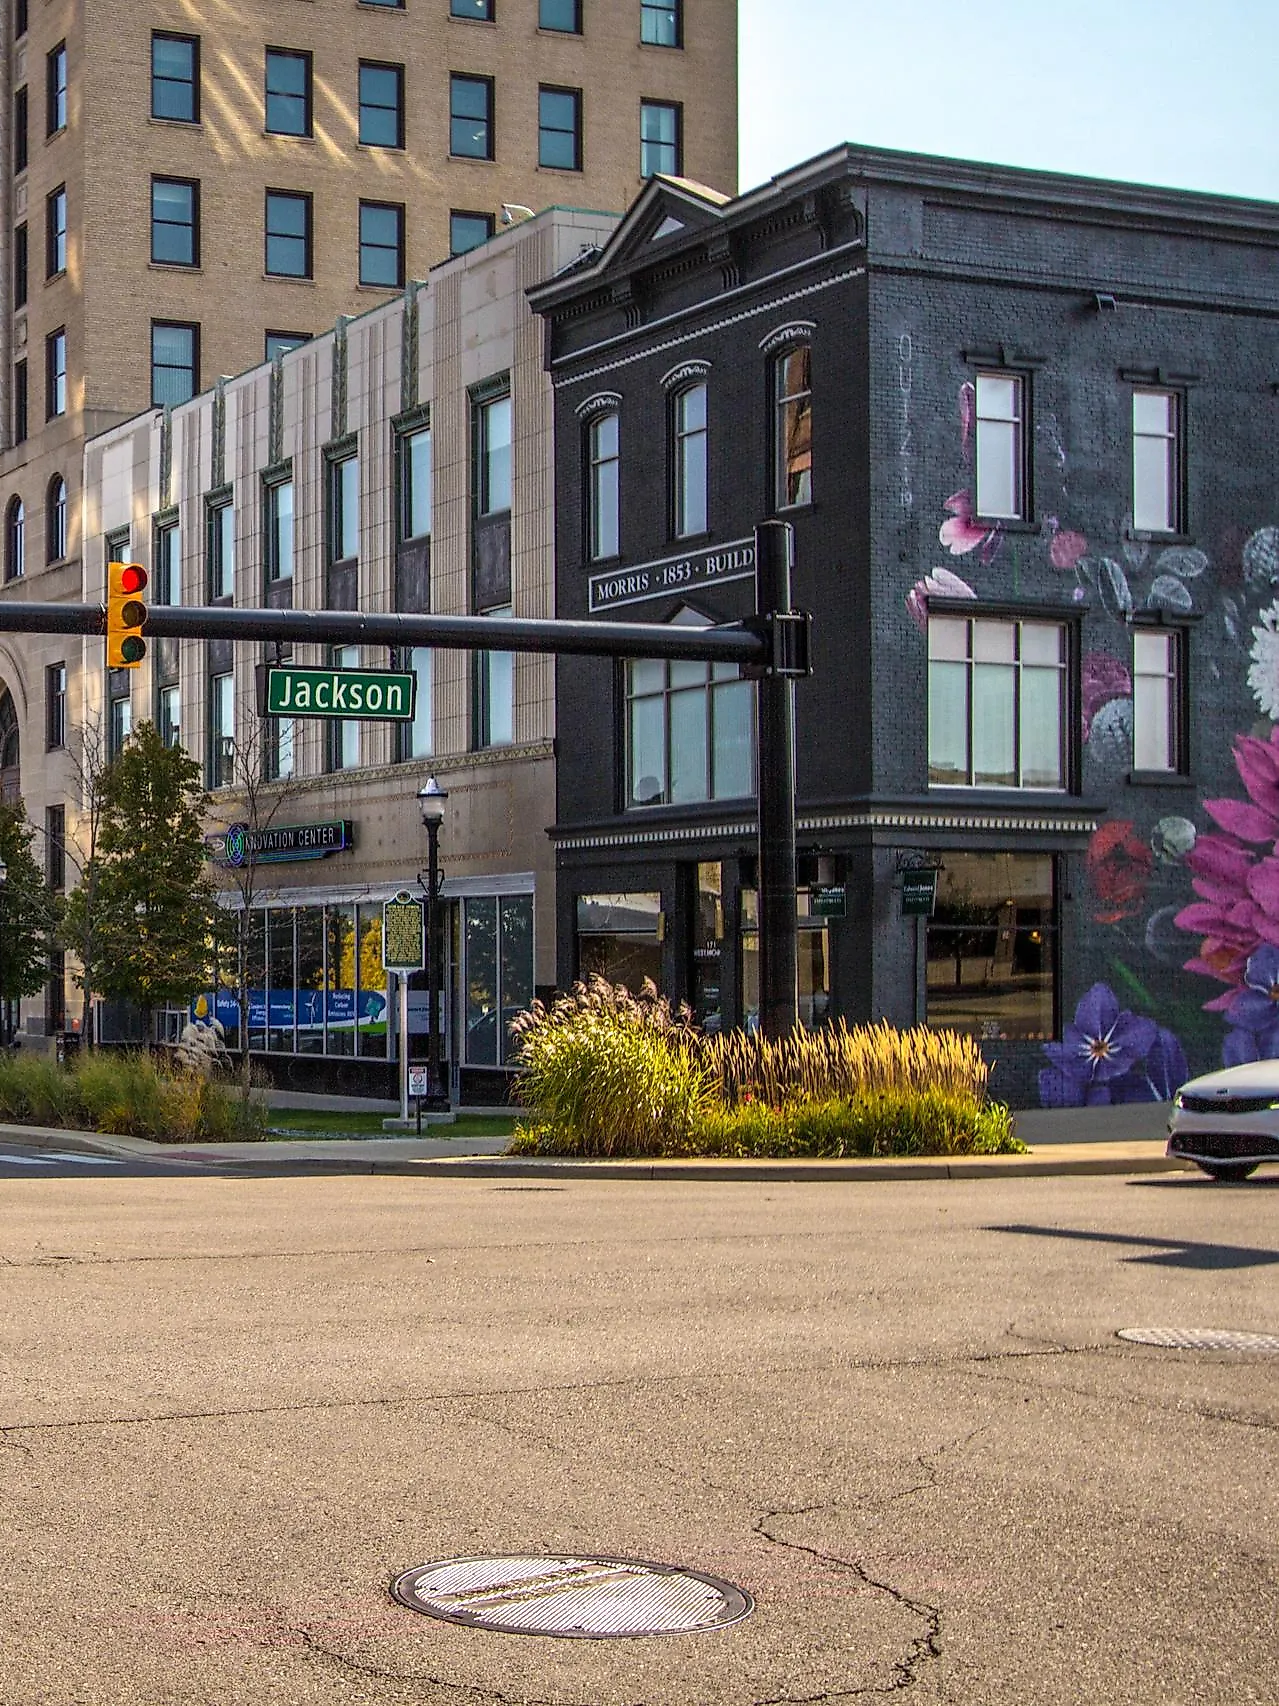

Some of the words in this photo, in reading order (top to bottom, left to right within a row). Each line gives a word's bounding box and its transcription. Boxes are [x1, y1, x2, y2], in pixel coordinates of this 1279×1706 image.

[598, 573, 649, 600] MORRIS
[706, 547, 755, 575] BUILD
[279, 676, 402, 710] Jackson
[243, 832, 294, 851] NNOVATION
[298, 827, 334, 849] CENTER
